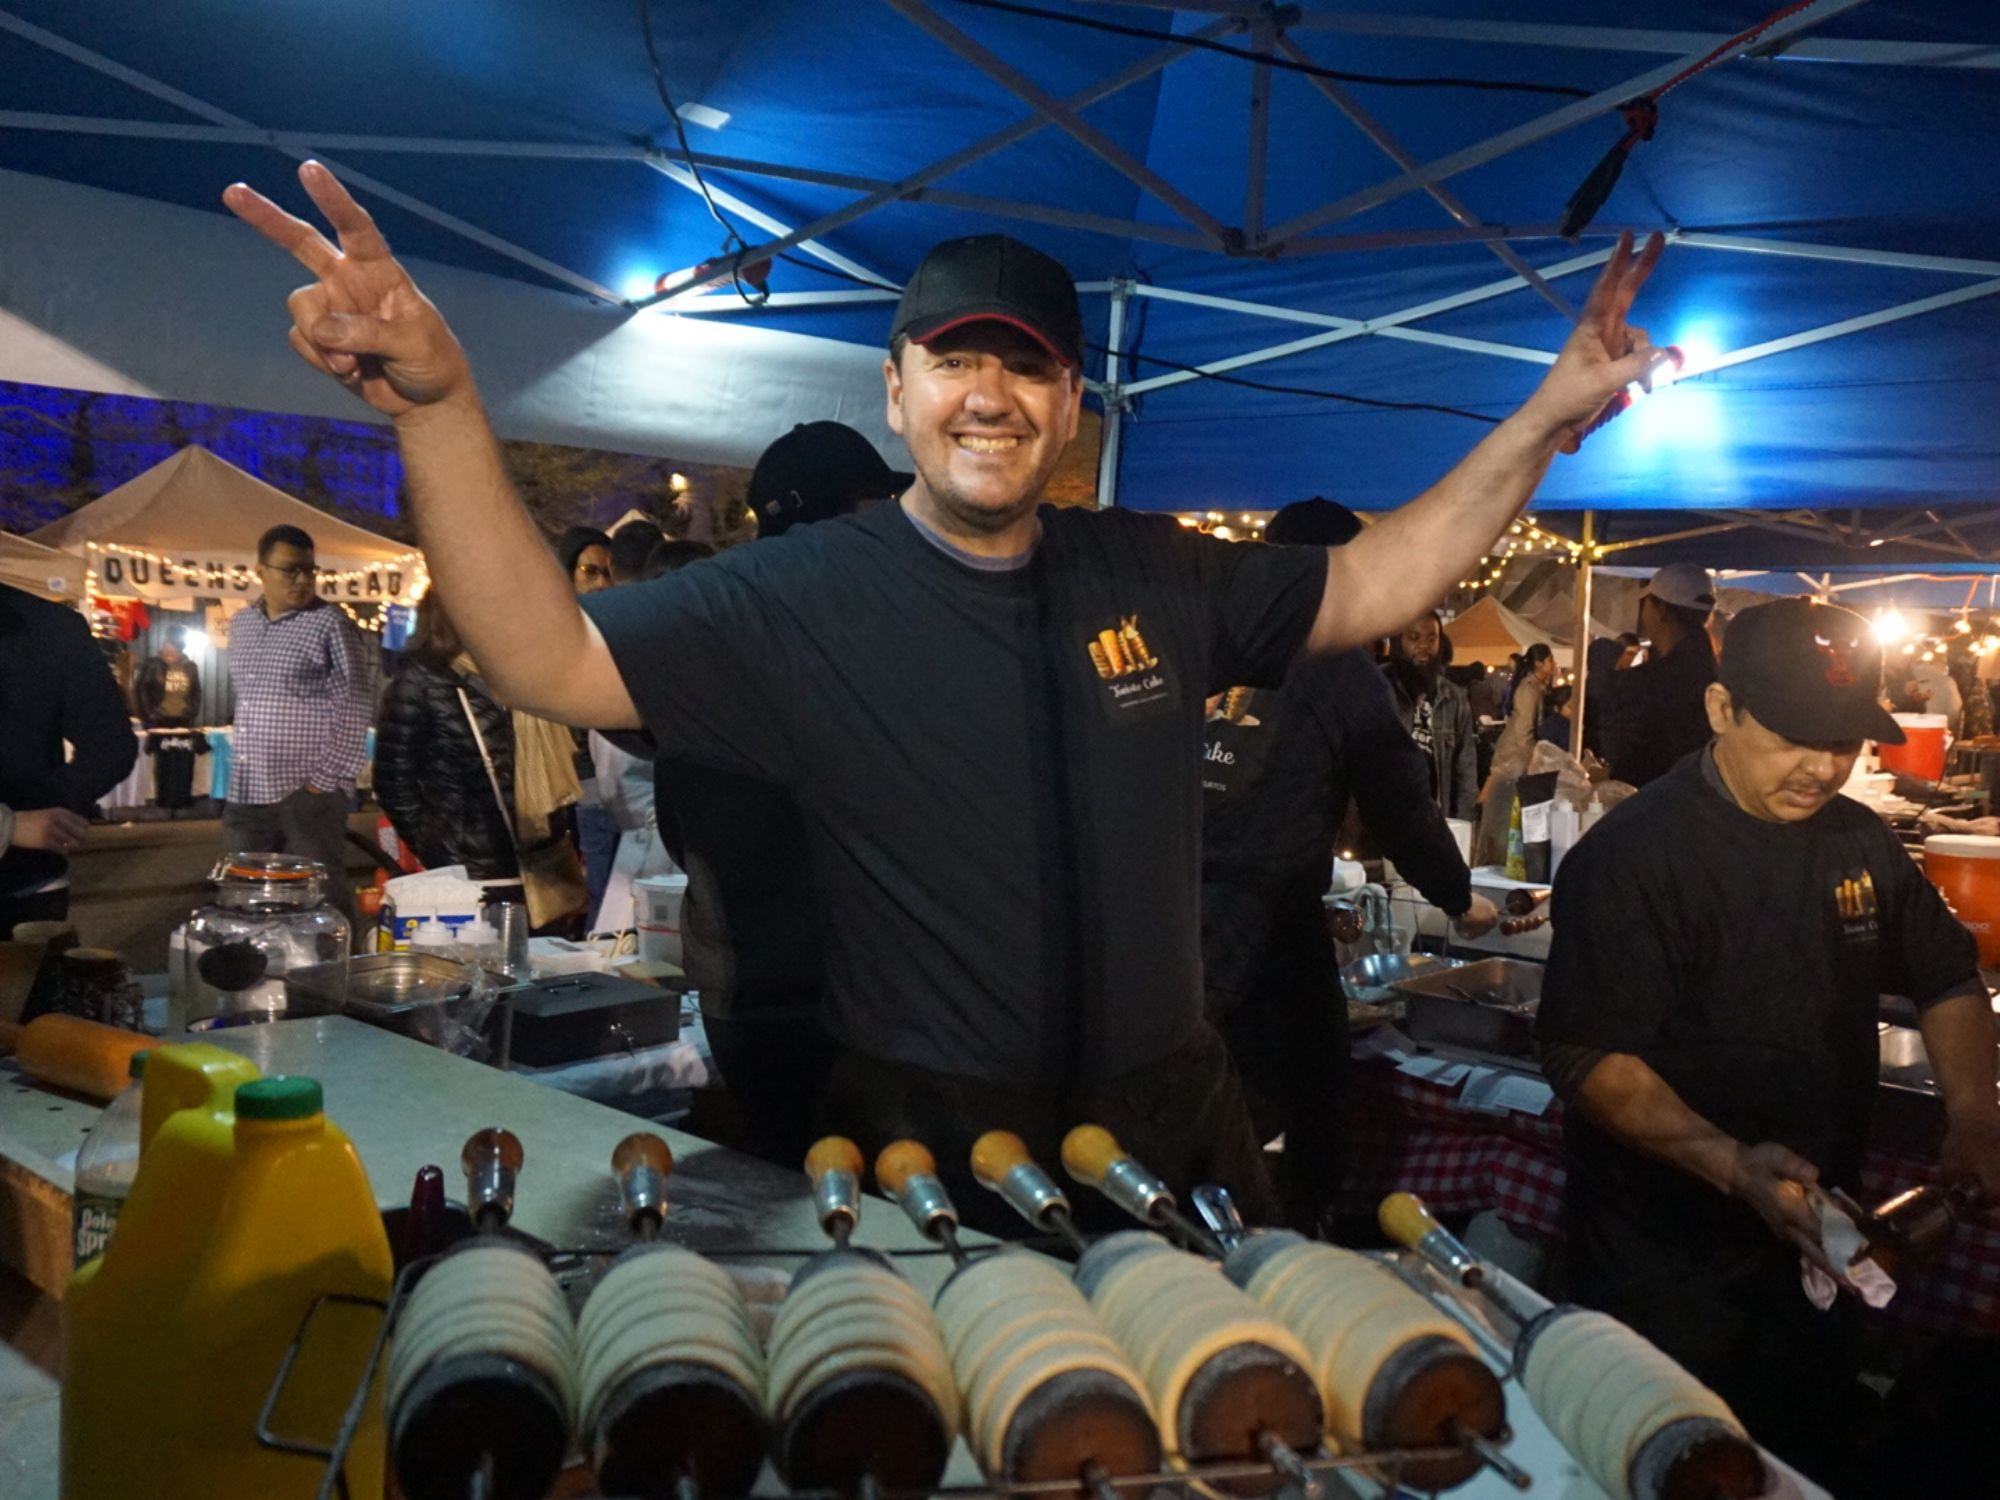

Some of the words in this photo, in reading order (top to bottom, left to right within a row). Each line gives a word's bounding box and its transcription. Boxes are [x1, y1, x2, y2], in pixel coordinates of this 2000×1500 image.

[105, 558, 249, 591] QUEENS
[321, 569, 402, 596] READ
[1202, 741, 1235, 765] ake
[82, 1208, 116, 1231] Pola
[76, 1228, 108, 1257] Spr
